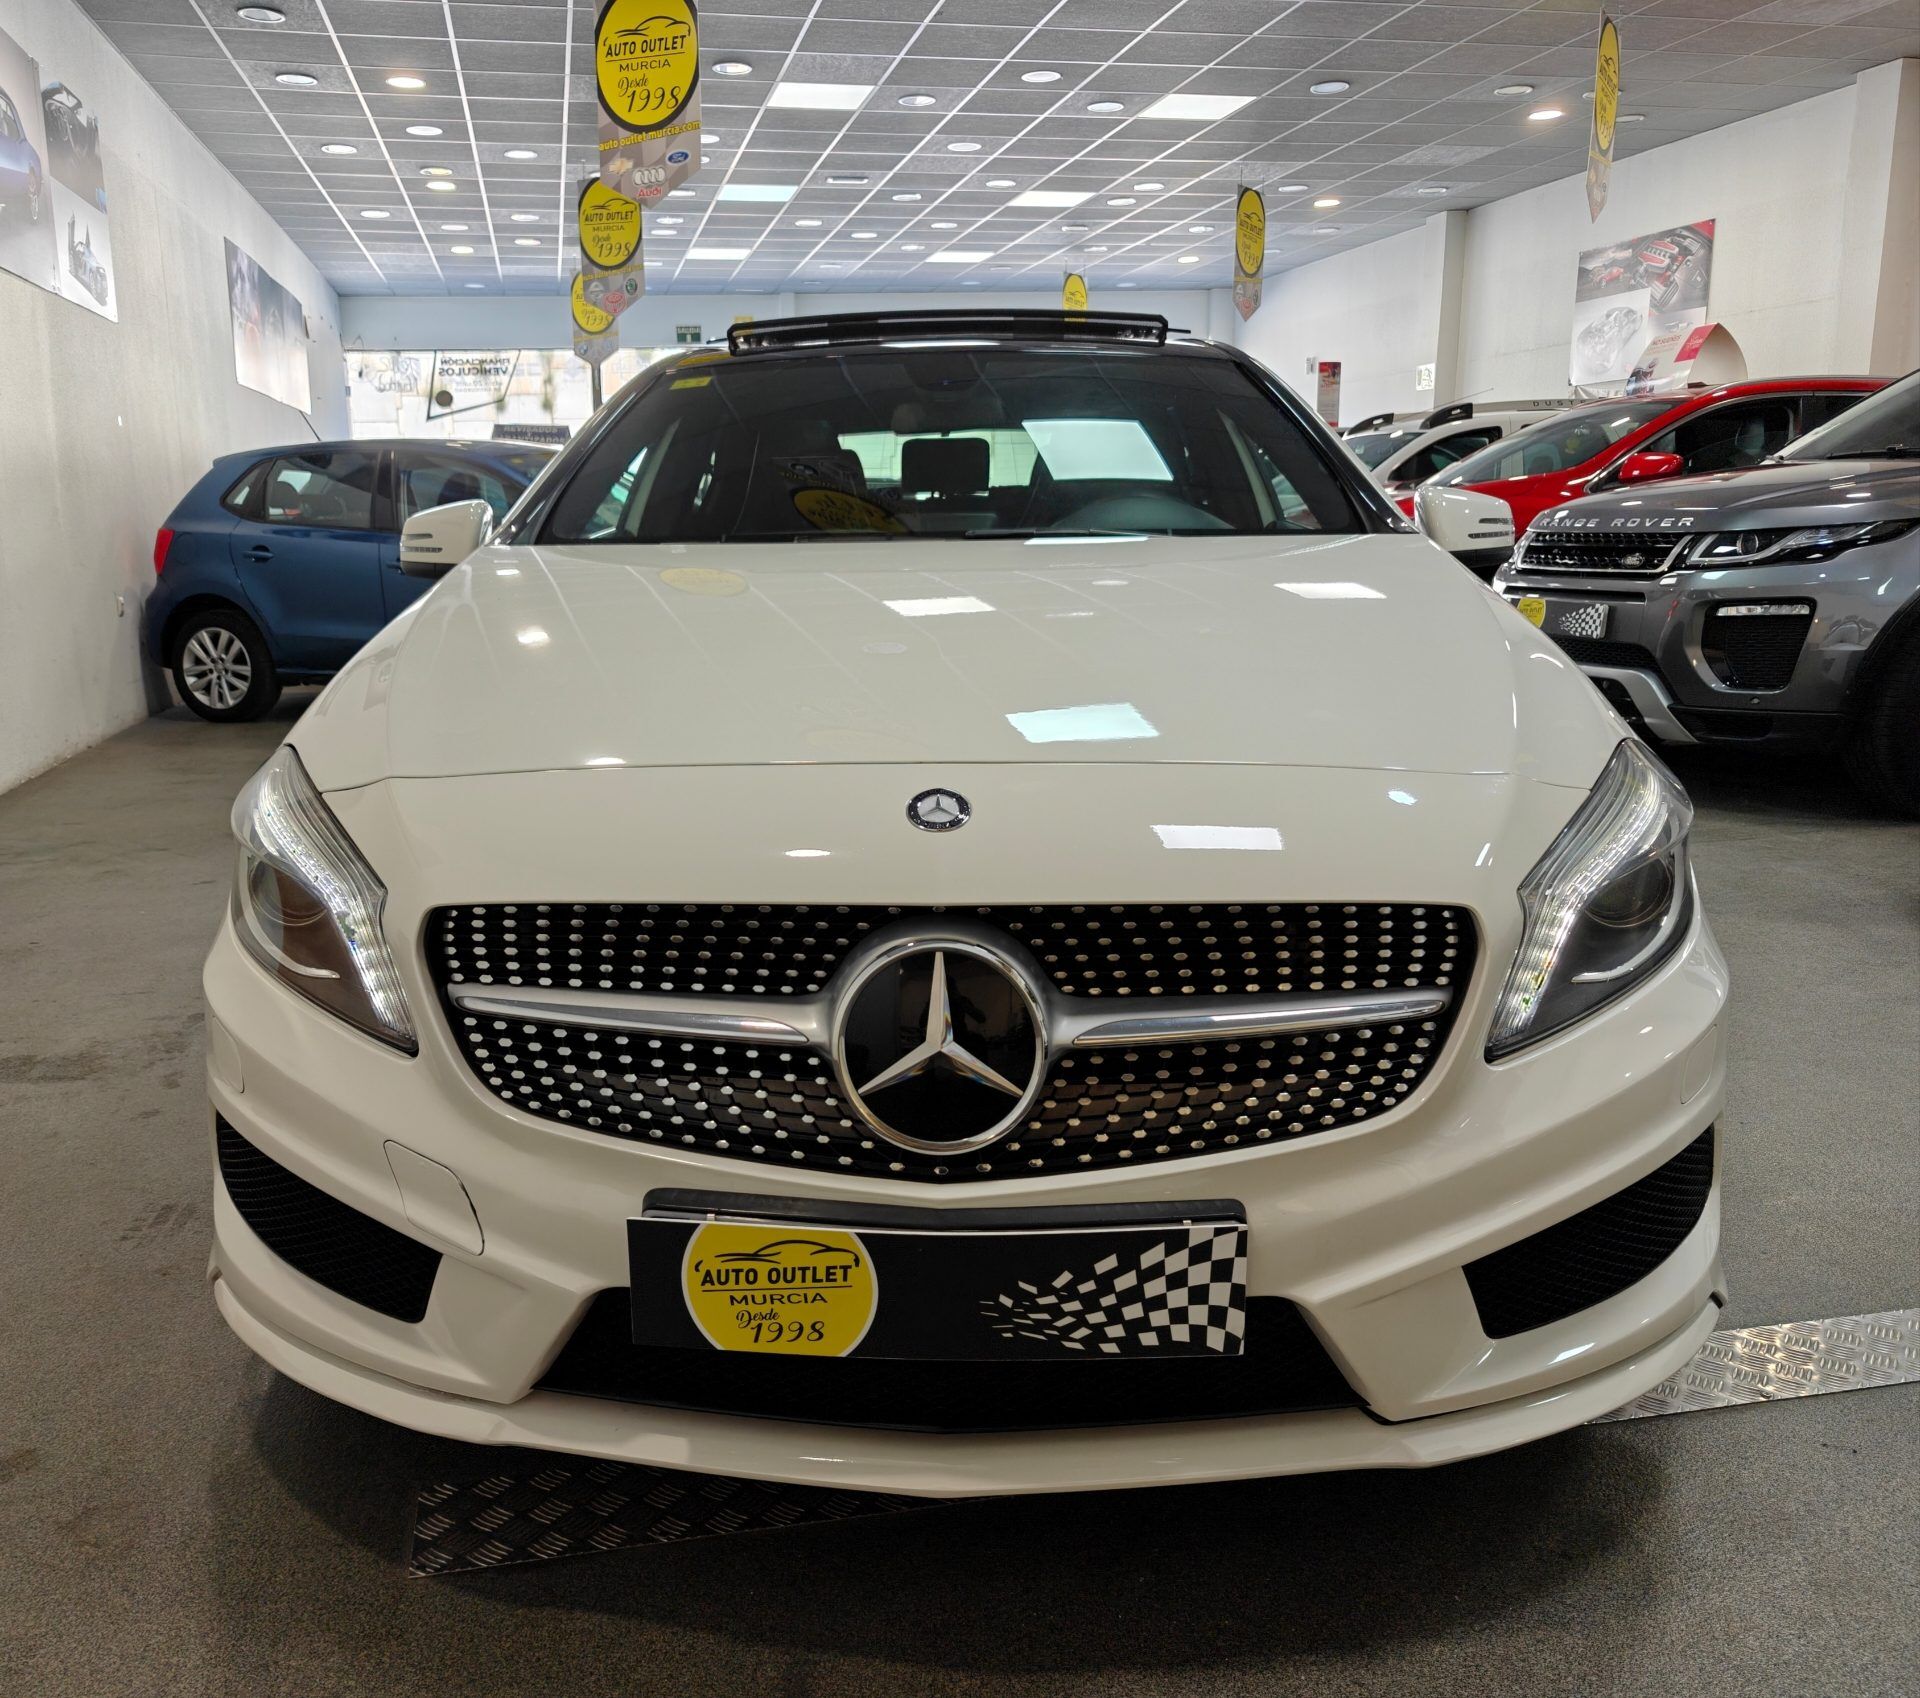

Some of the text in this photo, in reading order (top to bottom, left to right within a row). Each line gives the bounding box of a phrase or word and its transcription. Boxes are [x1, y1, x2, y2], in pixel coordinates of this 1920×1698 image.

[605, 35, 687, 58] AUTO OUTLET
[619, 59, 671, 73] MURCIA
[618, 74, 649, 97] Desde
[627, 86, 681, 112] 1998
[638, 187, 662, 197] Audi
[584, 211, 634, 223] AUTO OUTLET
[592, 225, 625, 233] MURCIA
[598, 241, 632, 258] 1998
[1539, 517, 1695, 527] RANGE ROVER
[701, 1265, 853, 1286] AUTO OUTLET
[729, 1293, 828, 1306] MURCIA
[736, 1308, 780, 1329] Desde
[750, 1320, 826, 1344] 1998
